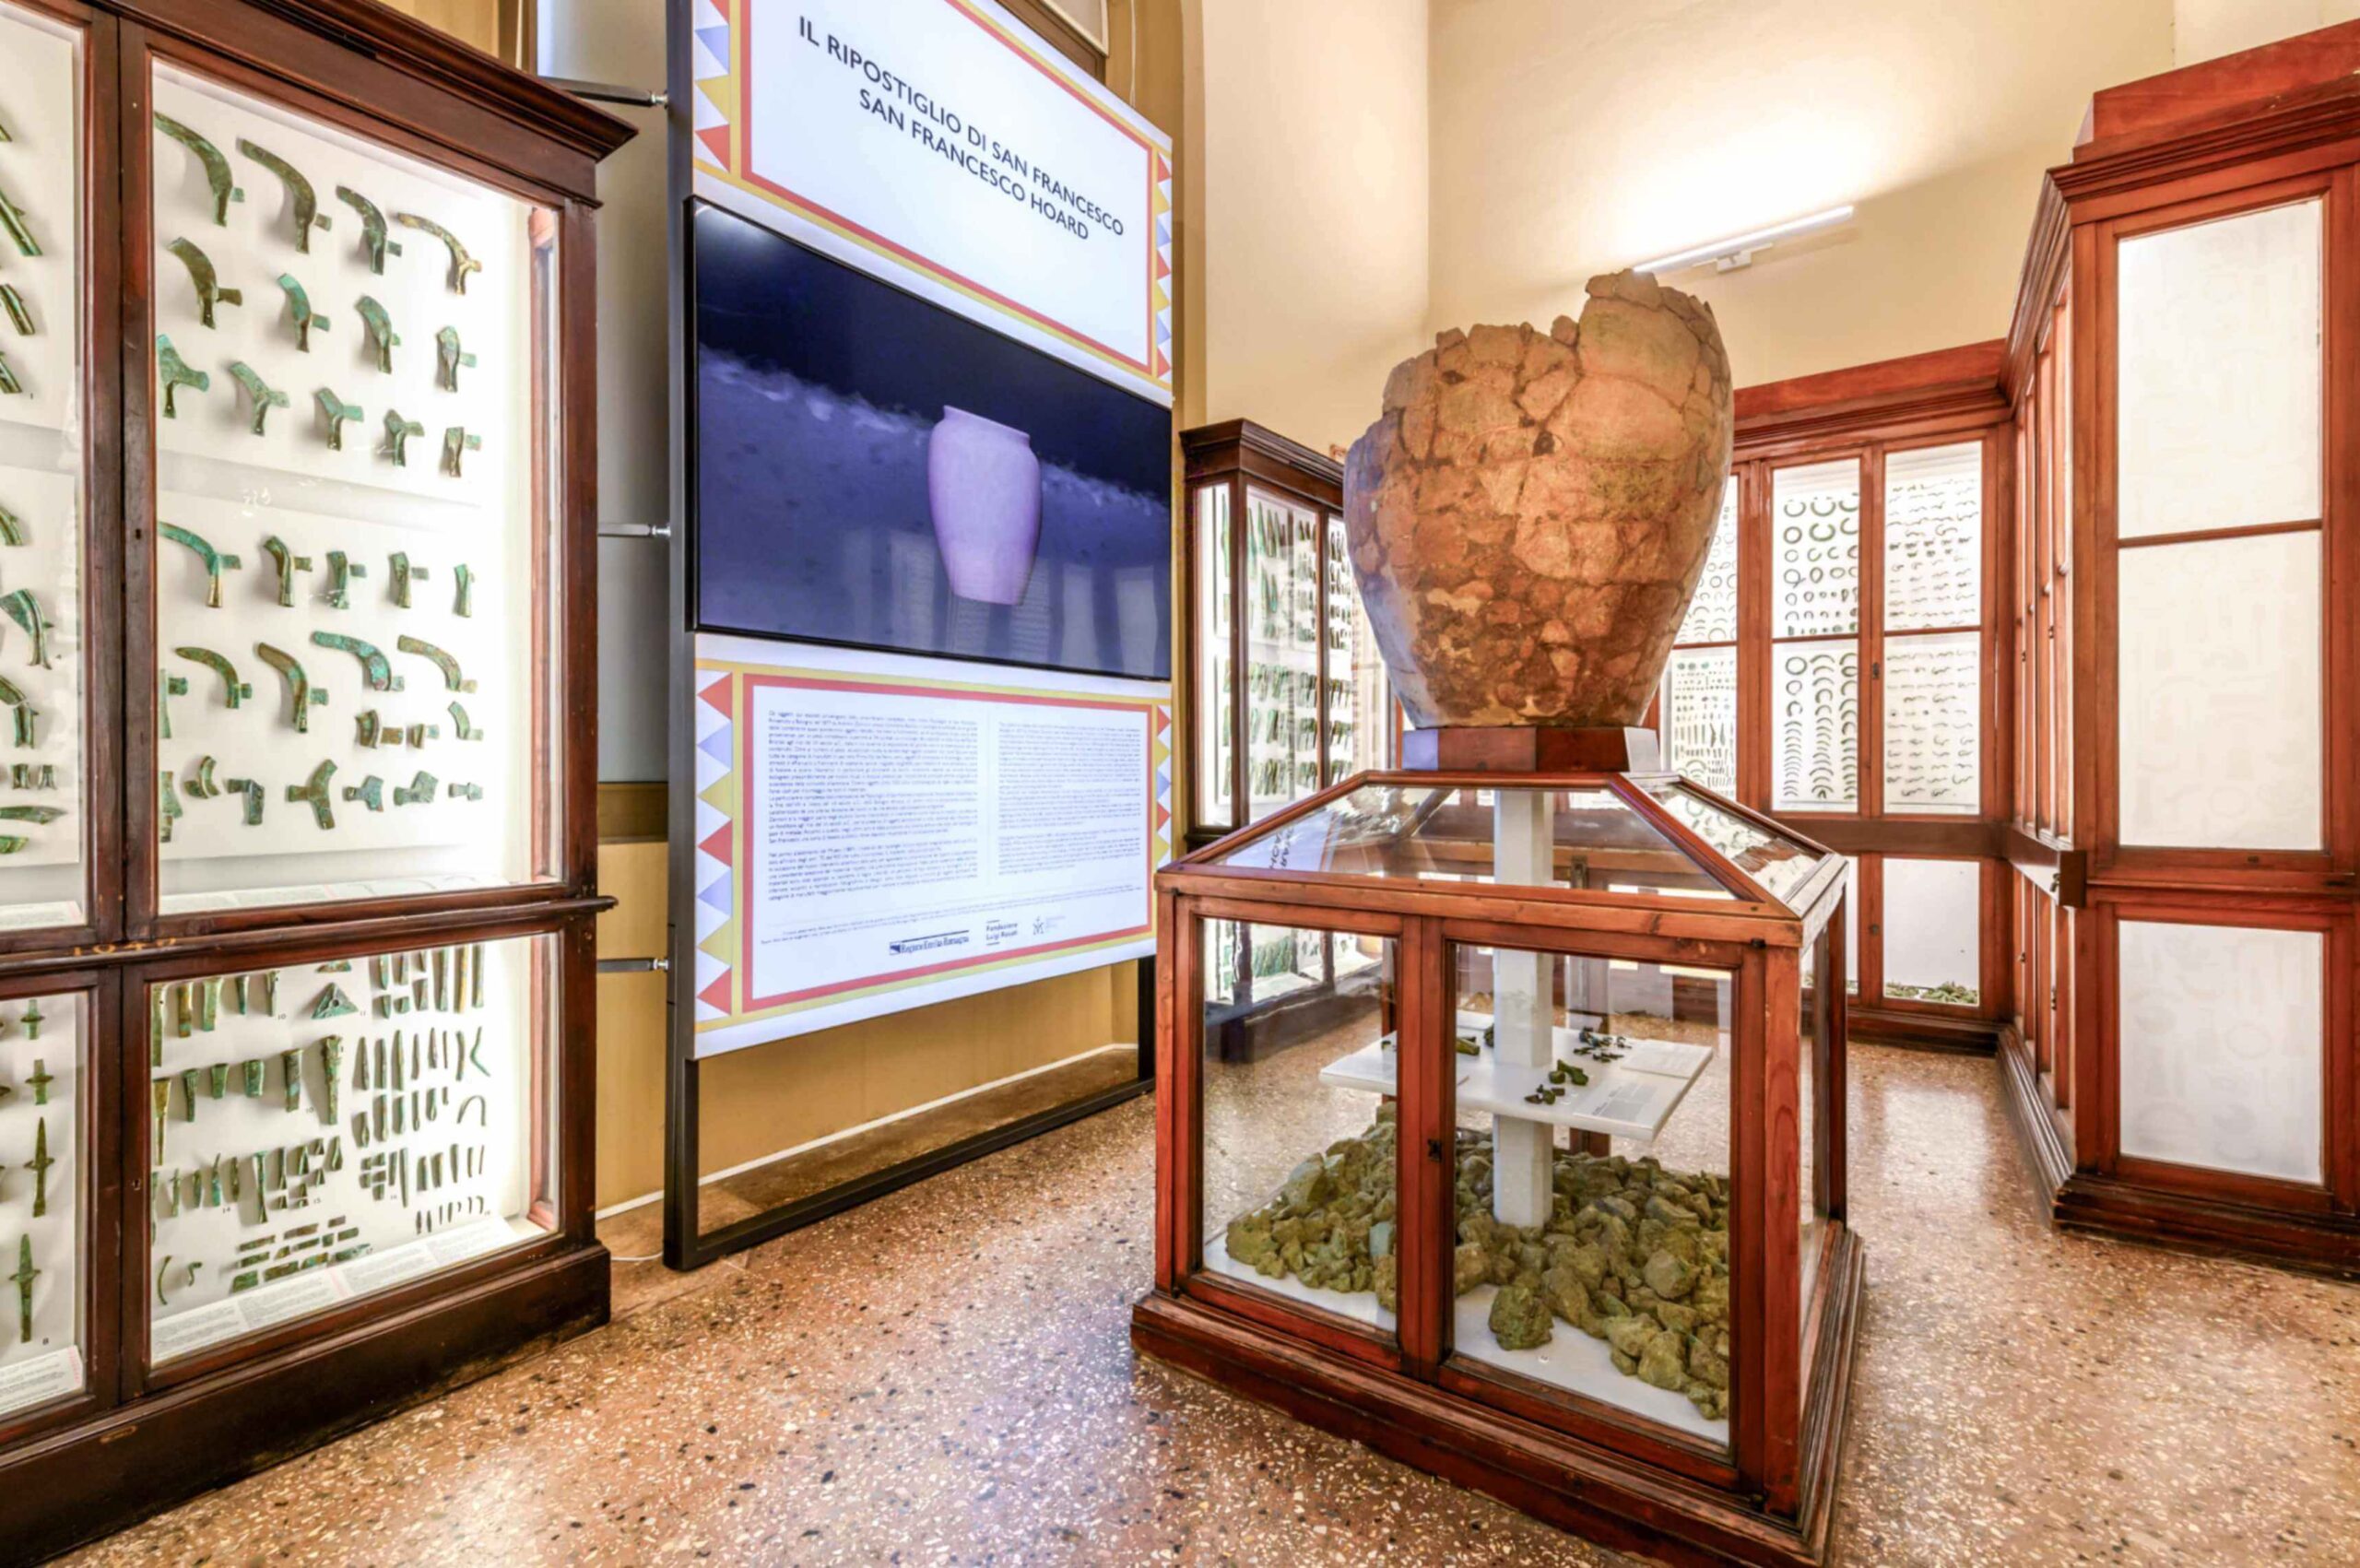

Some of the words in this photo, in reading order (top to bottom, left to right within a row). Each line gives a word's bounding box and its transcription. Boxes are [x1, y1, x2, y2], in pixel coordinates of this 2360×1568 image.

[799, 15, 820, 48] IL
[827, 33, 962, 135] RIPOSTIGLIO
[967, 124, 986, 152] DI
[992, 141, 1028, 178] SAN
[1032, 166, 1124, 236] FRANCESCO
[859, 88, 904, 132] SAN
[911, 119, 1026, 202] FRANCESCO
[1031, 192, 1089, 241] HOARD
